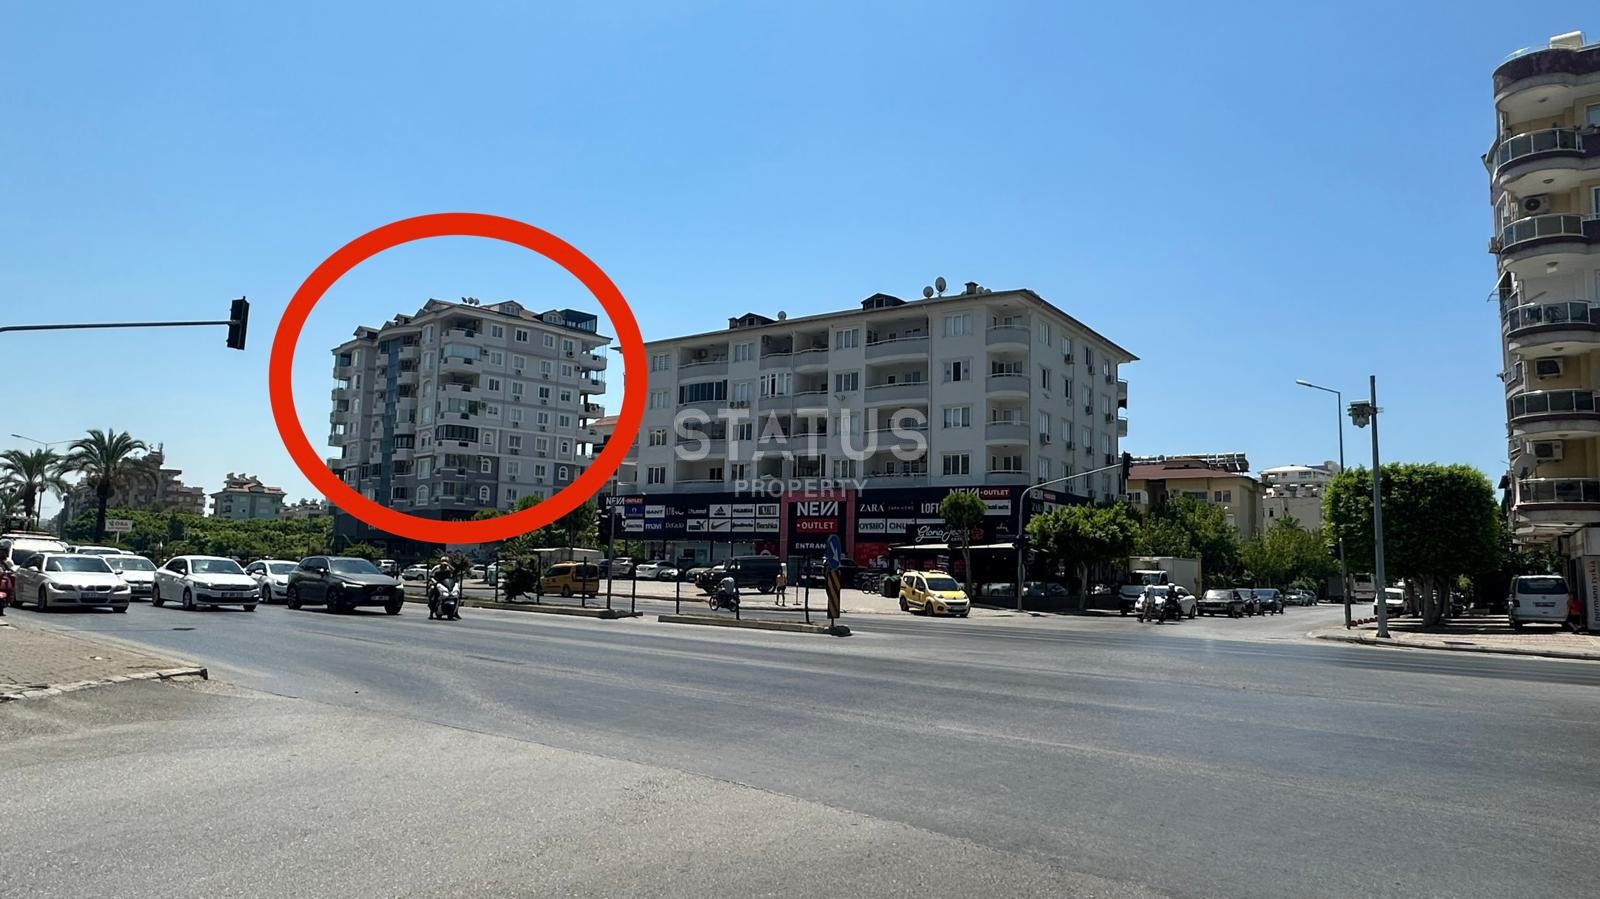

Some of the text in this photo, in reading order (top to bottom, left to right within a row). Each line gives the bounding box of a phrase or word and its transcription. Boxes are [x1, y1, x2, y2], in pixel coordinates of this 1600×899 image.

[796, 501, 839, 517] NEVA
[859, 503, 885, 513] ZARA
[645, 522, 662, 530] mavi
[801, 521, 834, 529] OUTLET
[795, 542, 827, 550] ENTRAN
